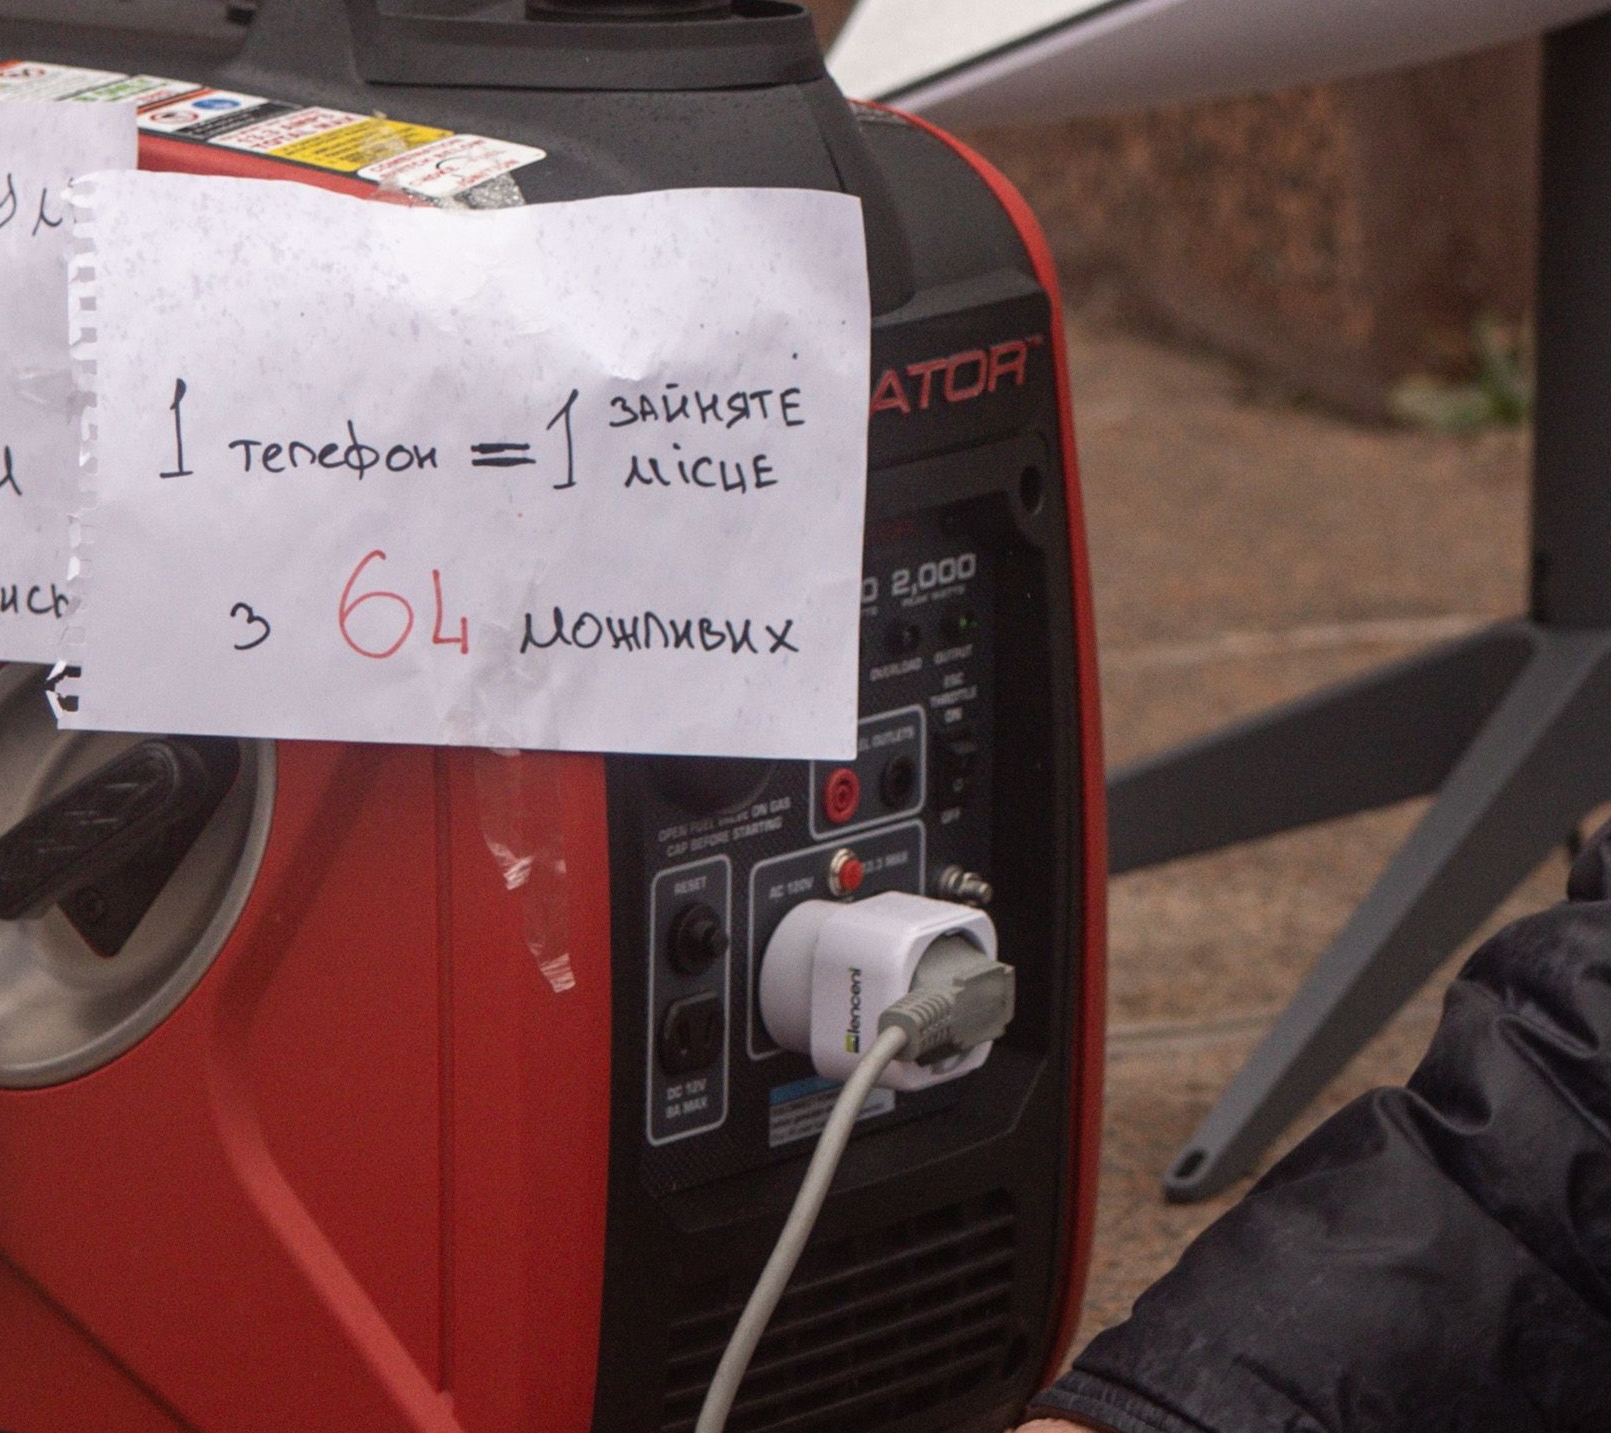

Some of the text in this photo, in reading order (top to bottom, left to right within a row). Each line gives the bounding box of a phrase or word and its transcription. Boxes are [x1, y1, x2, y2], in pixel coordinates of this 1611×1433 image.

[159, 377, 194, 479] 1
[228, 419, 440, 480] телефон
[545, 388, 580, 490] 1
[337, 548, 469, 660] 64
[891, 552, 978, 598] 2,000
